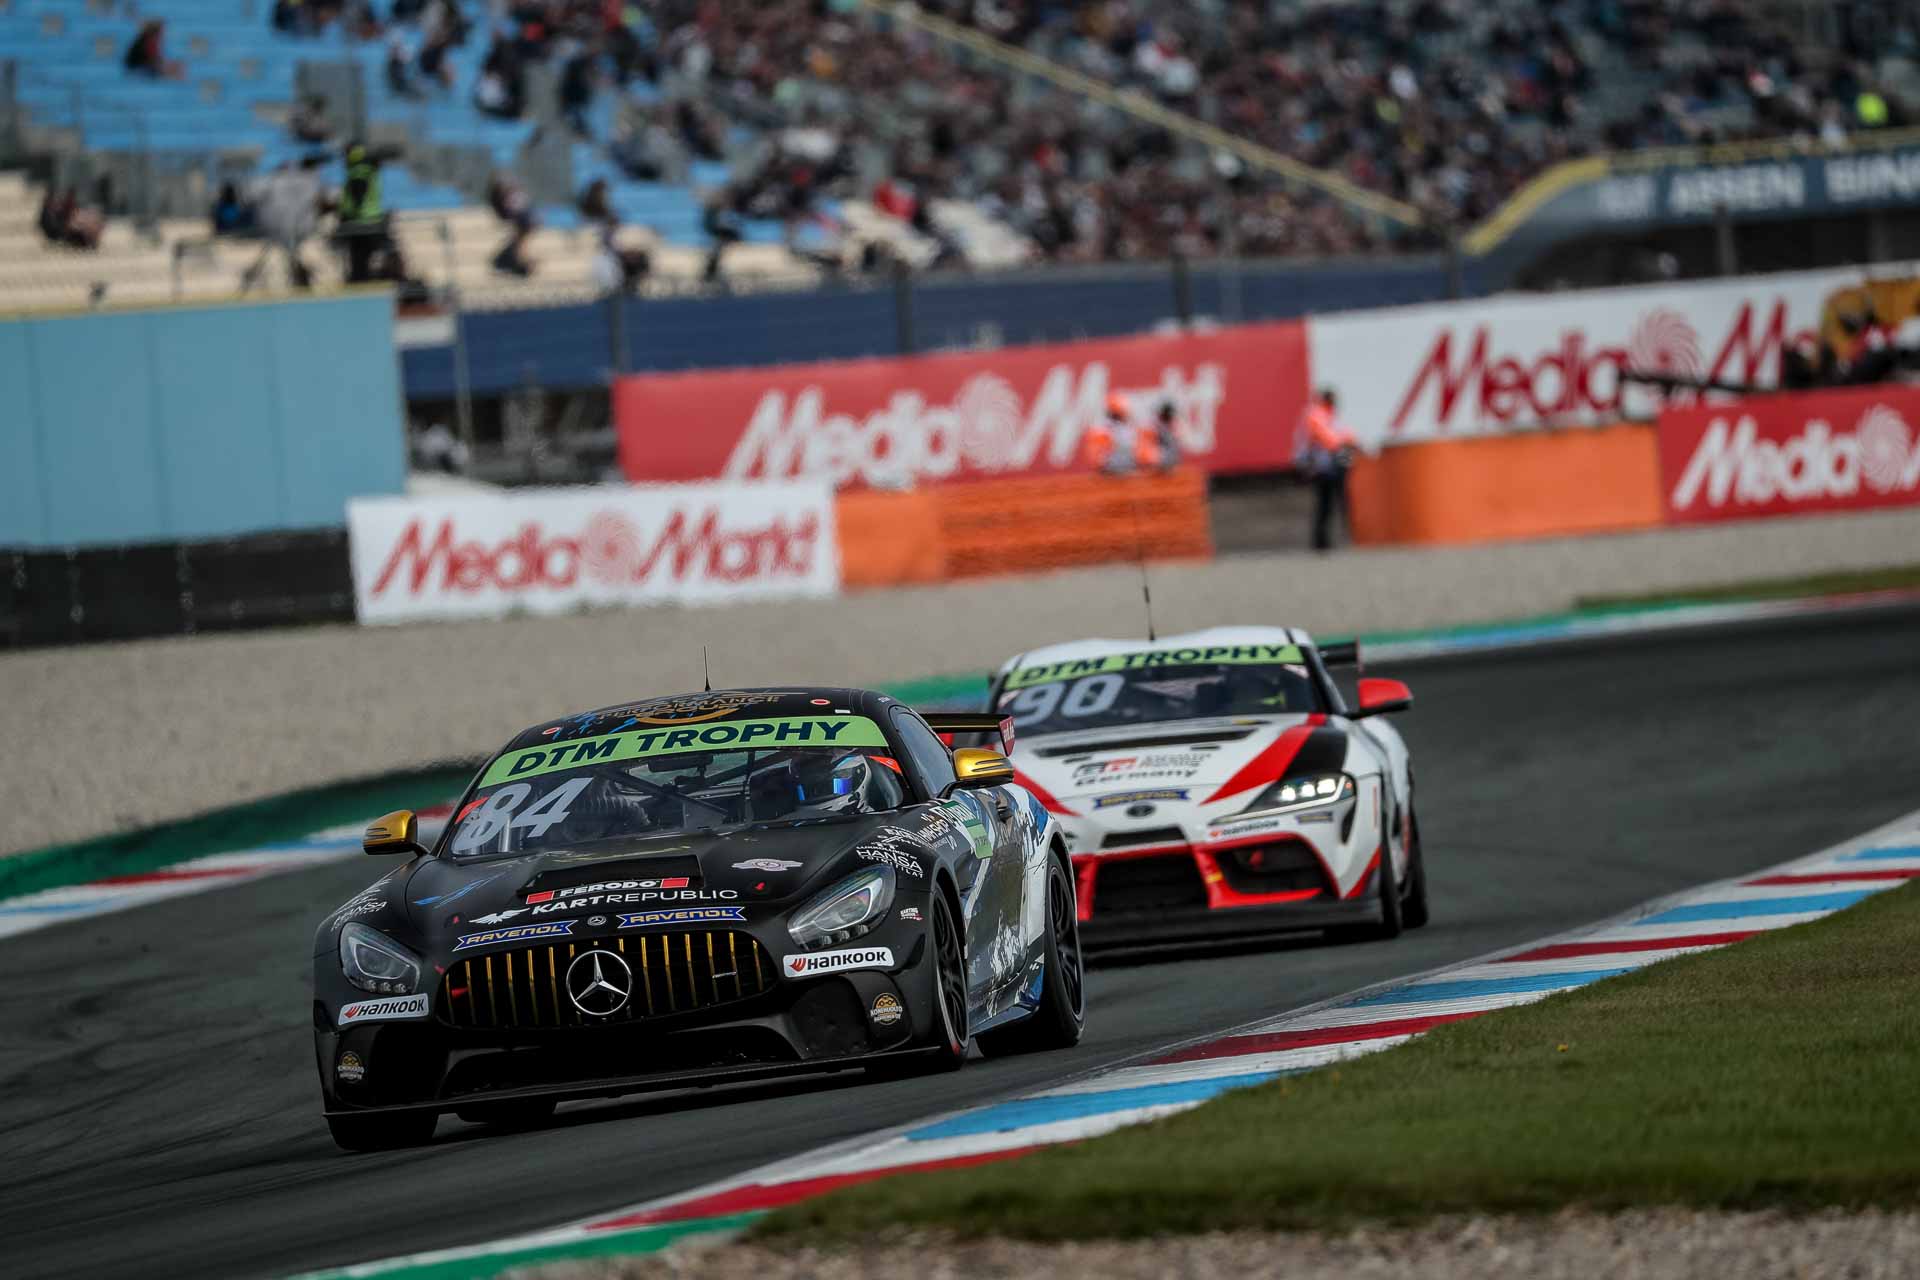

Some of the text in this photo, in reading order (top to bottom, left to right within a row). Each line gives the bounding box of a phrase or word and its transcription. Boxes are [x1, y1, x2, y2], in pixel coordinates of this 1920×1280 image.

[1021, 645, 1288, 681] DTM TROPHY
[1013, 673, 1125, 727] 90
[507, 720, 851, 777] DTM TROPHY
[450, 777, 594, 855] 84
[856, 849, 923, 874] HANSA
[559, 879, 658, 897] FERODO
[629, 909, 733, 924] RAVENOL
[466, 924, 565, 944] RAVENOL
[807, 951, 888, 970] HANKOOK
[357, 999, 424, 1016] HANKOOK
